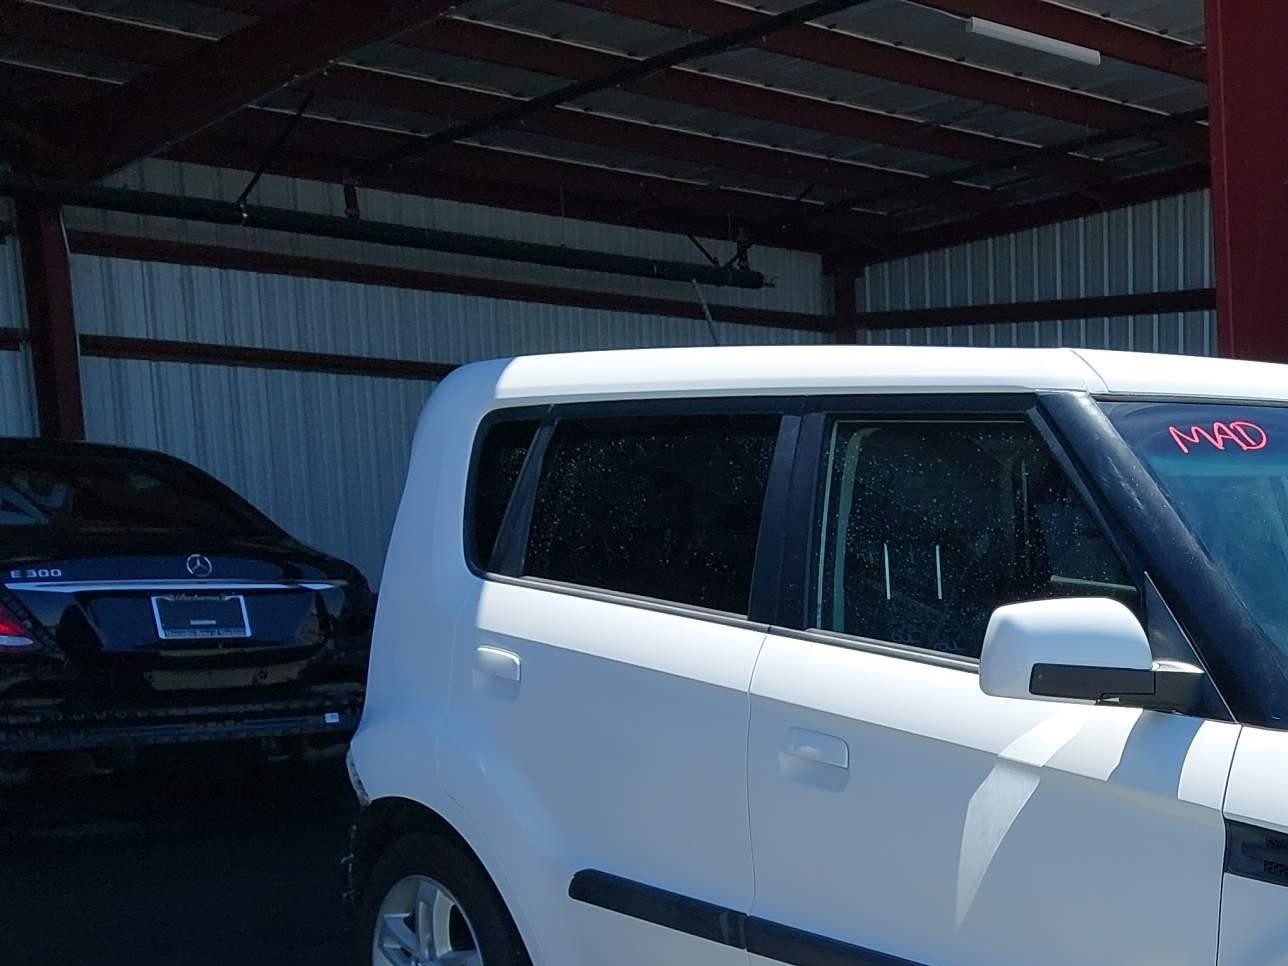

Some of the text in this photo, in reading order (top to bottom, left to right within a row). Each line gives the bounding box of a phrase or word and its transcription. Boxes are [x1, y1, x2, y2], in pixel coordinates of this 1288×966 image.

[1168, 421, 1267, 454] MAD
[10, 568, 62, 579] E 300
